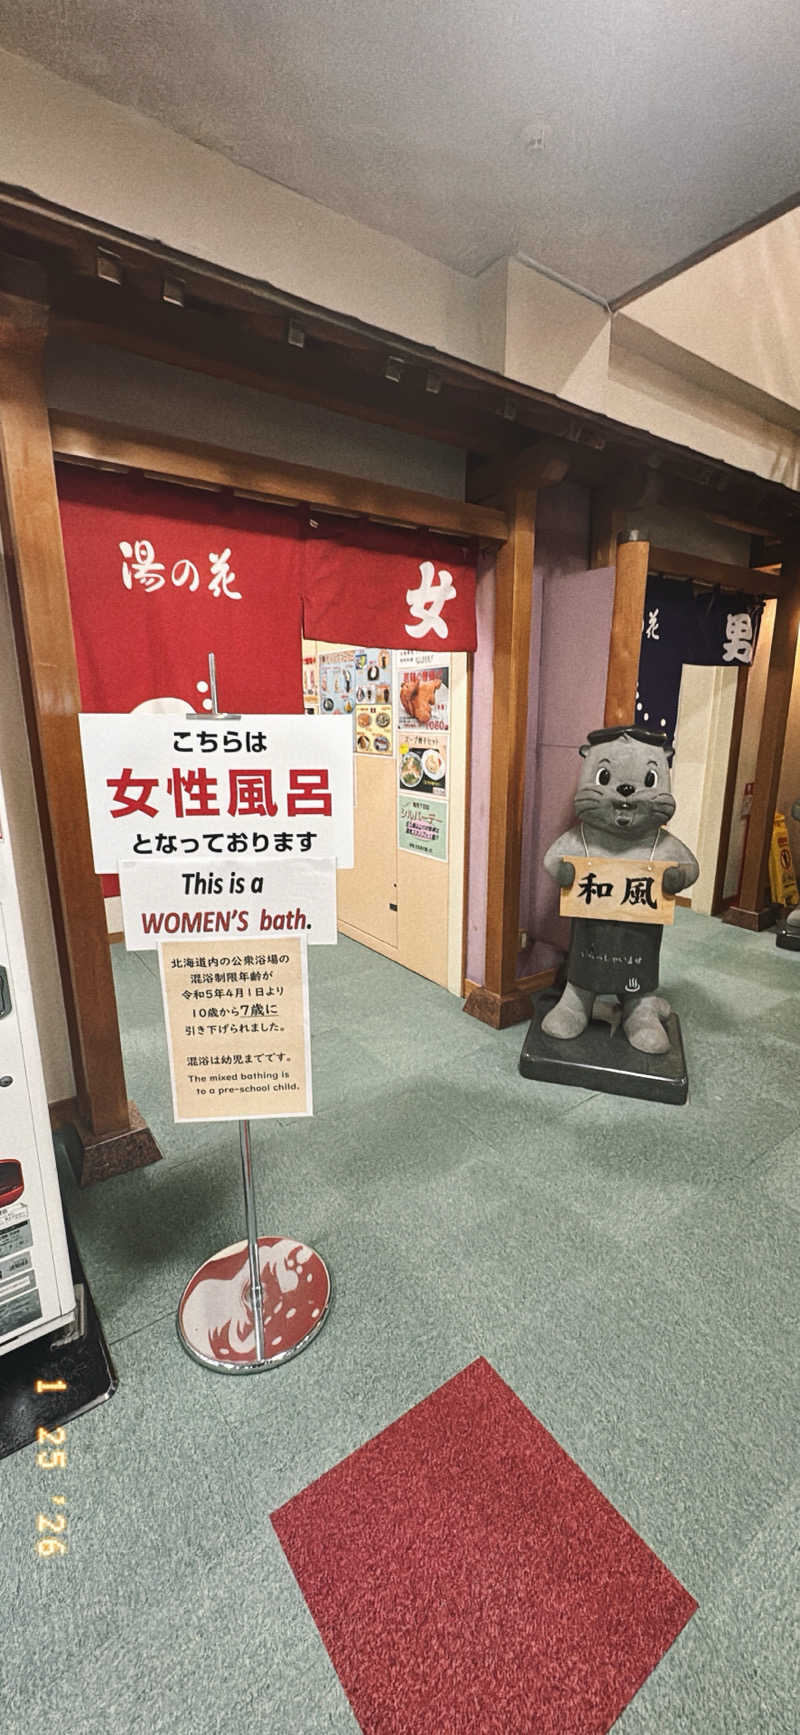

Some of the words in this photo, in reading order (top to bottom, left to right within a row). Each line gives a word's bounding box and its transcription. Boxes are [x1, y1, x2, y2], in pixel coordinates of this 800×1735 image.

[118, 540, 242, 600] 湯の花
[404, 561, 457, 639] 女
[641, 608, 660, 641] 花
[723, 613, 753, 664] 男
[172, 731, 268, 753] こちらは
[106, 767, 333, 818] 女性風呂
[132, 832, 318, 854] となっております
[181, 872, 223, 895] This
[229, 872, 245, 894] is
[251, 877, 264, 894] a
[577, 872, 659, 910] 和風
[141, 910, 249, 935] WOMEN'S
[259, 908, 313, 931] bath.
[171, 954, 289, 968] 北海道内の公衆浴場の
[190, 971, 274, 984] 混浴制限年齢が
[181, 986, 285, 1000] 令和5年4月1日より
[192, 1003, 279, 1018] 10歳から7歳に
[184, 1022, 286, 1036] 引き下げられました。
[186, 1052, 292, 1066] 混浴は幼児までです。
[188, 1074, 207, 1083] The
[209, 1074, 238, 1082] mixed
[241, 1072, 278, 1081] bathing
[281, 1071, 290, 1079] is
[196, 1087, 206, 1095] to
[218, 1084, 271, 1096] pre-school
[273, 1082, 301, 1092] child.
